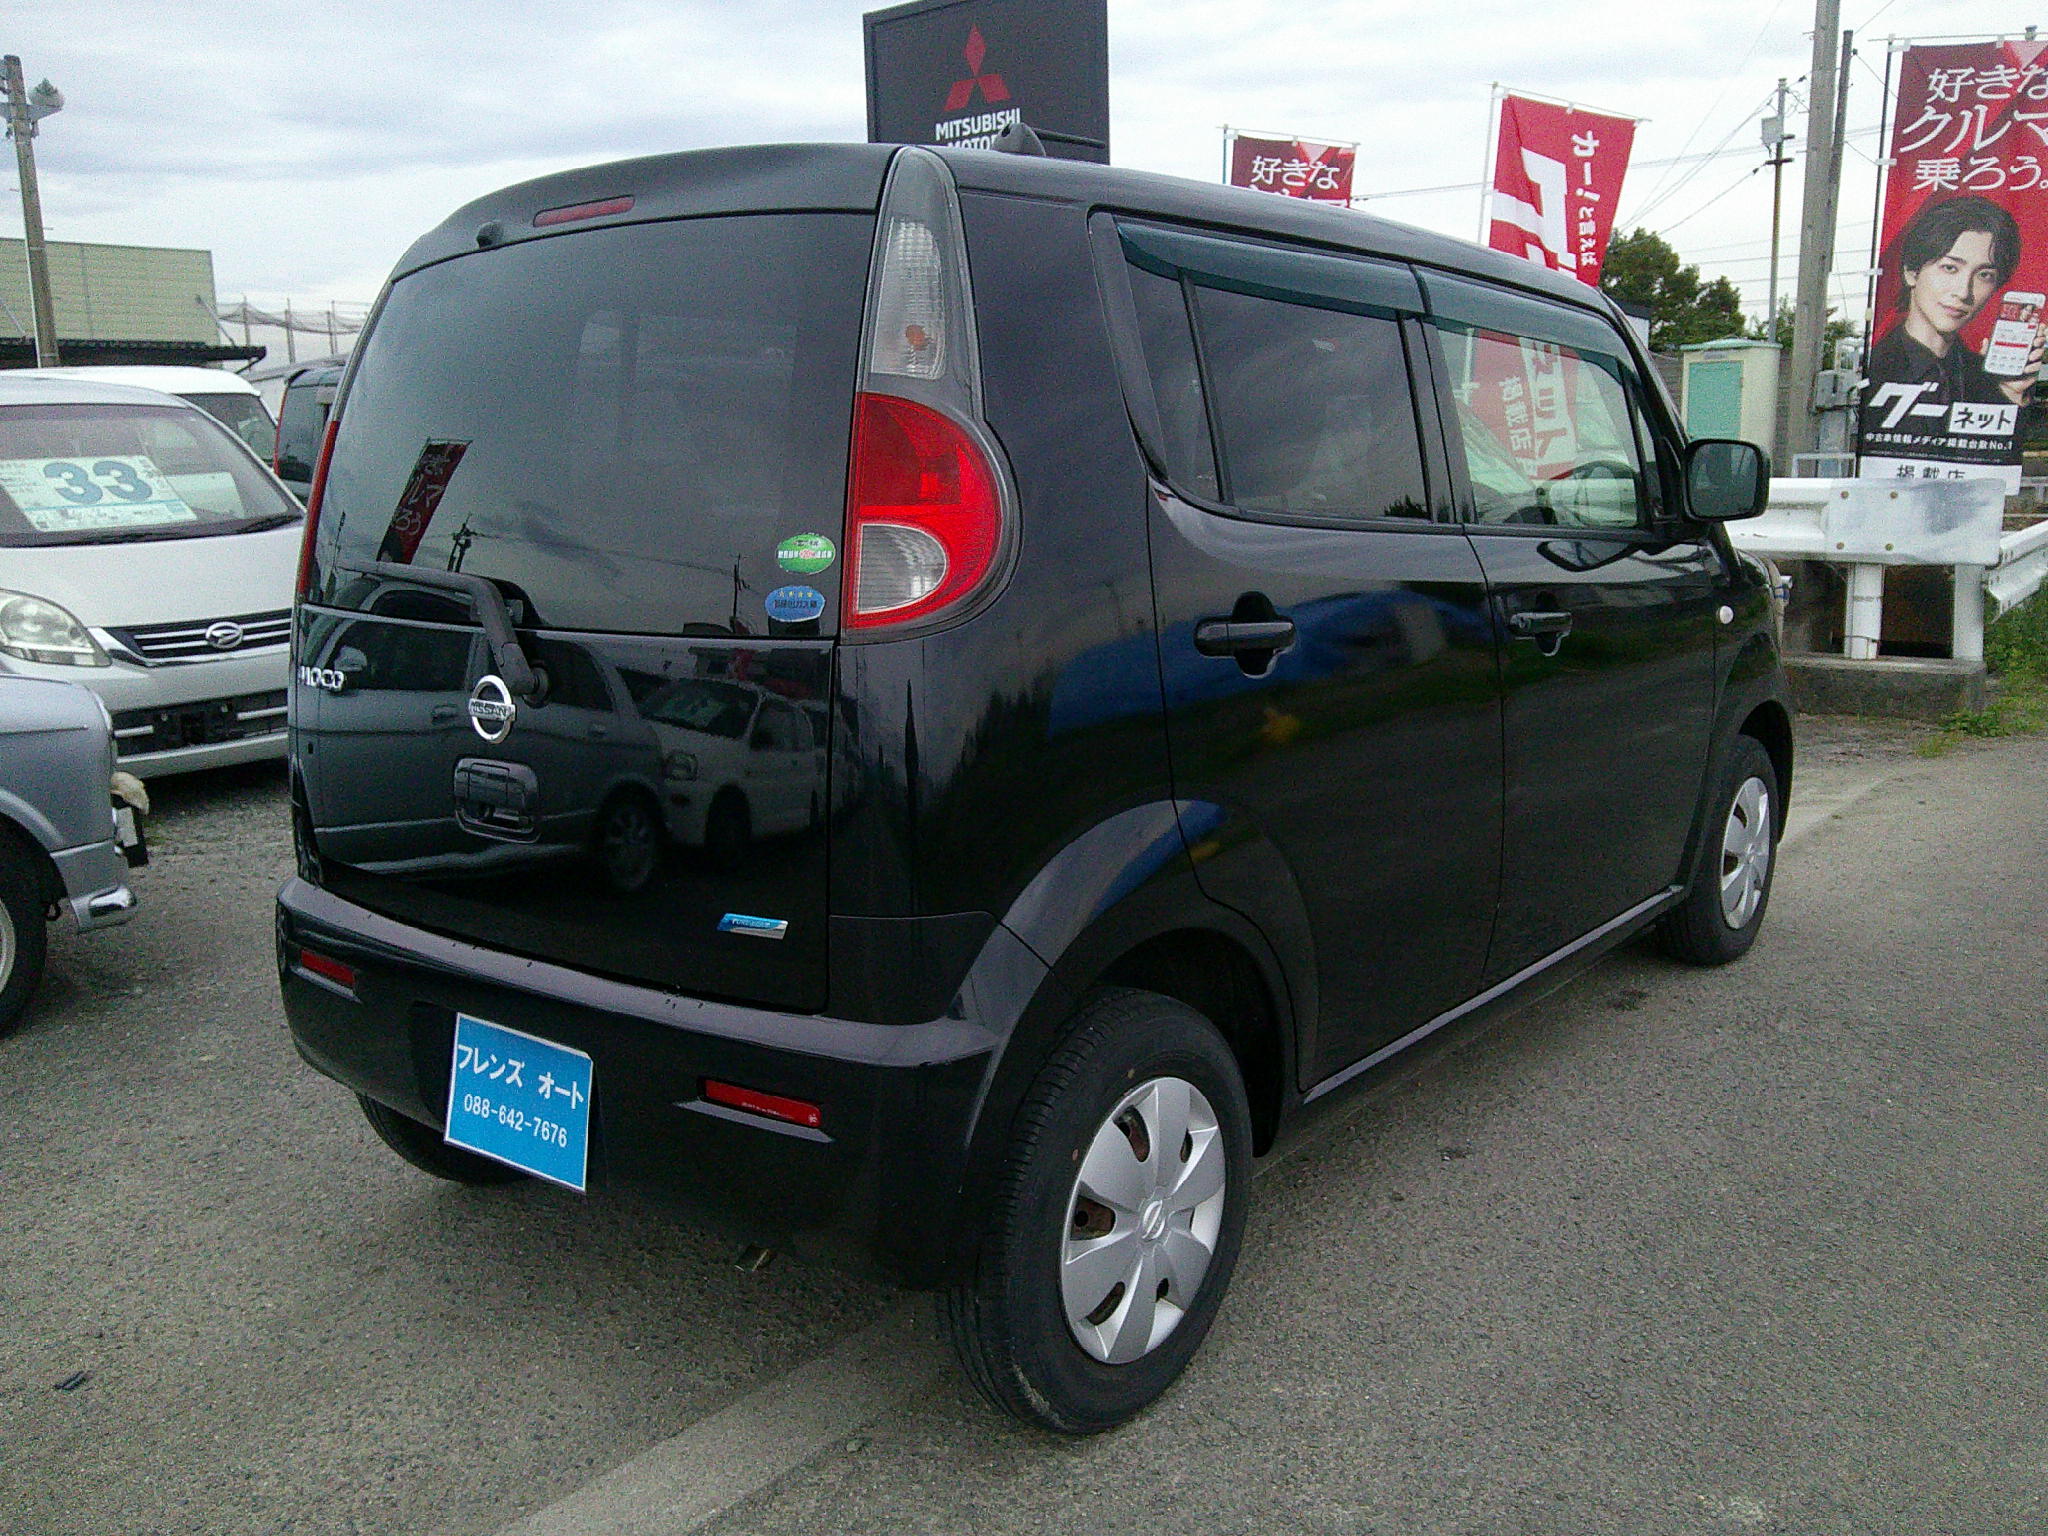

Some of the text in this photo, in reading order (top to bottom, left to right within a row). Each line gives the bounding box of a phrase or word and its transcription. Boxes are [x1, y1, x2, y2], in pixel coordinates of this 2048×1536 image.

[1926, 64, 2048, 104] 好きな
[935, 107, 1021, 142] MITSUBISHI
[1251, 155, 1340, 190] 好きな
[43, 460, 153, 505] 33
[469, 699, 508, 718] NISSAN
[457, 1043, 584, 1110] フレンズ オート
[463, 1093, 568, 1148] 088-642-7676
